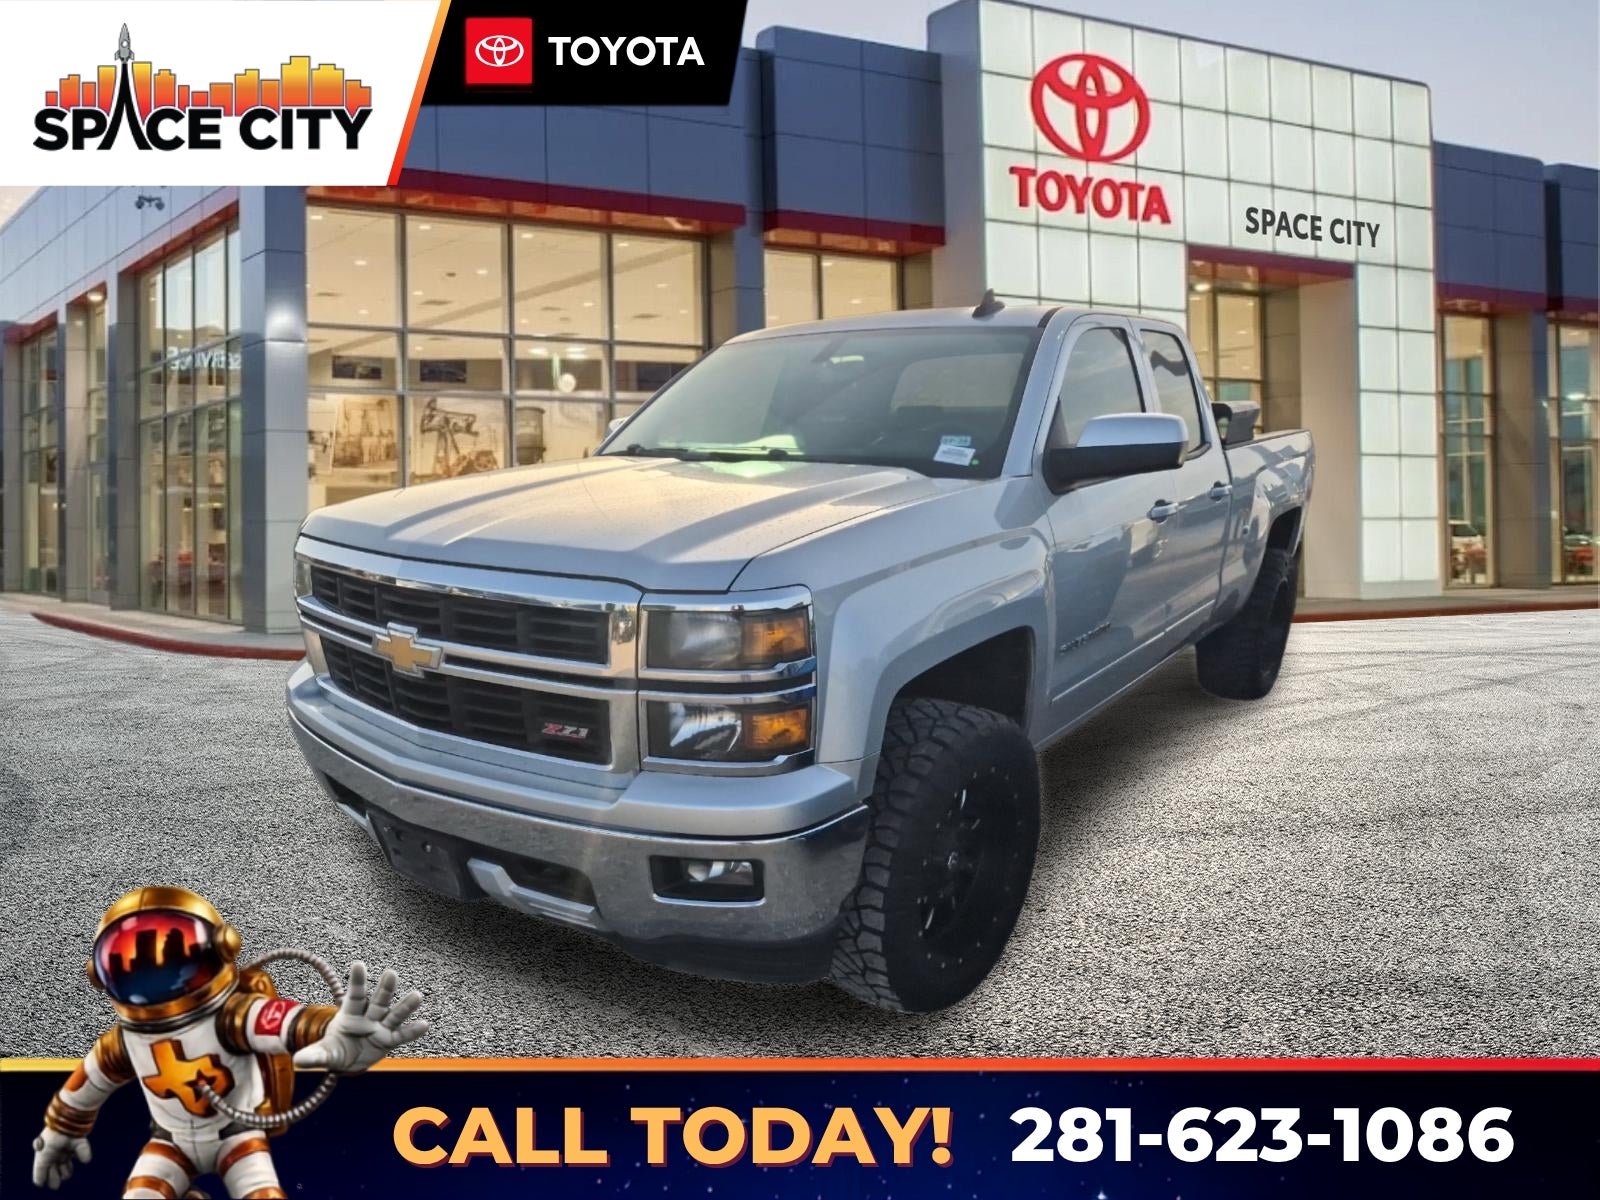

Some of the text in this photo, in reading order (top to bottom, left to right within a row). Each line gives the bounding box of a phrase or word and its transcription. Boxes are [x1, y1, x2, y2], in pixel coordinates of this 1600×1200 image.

[1009, 166, 1171, 225] TOYOTA
[1245, 206, 1381, 248] SPACE CITY
[541, 722, 589, 740] Z71
